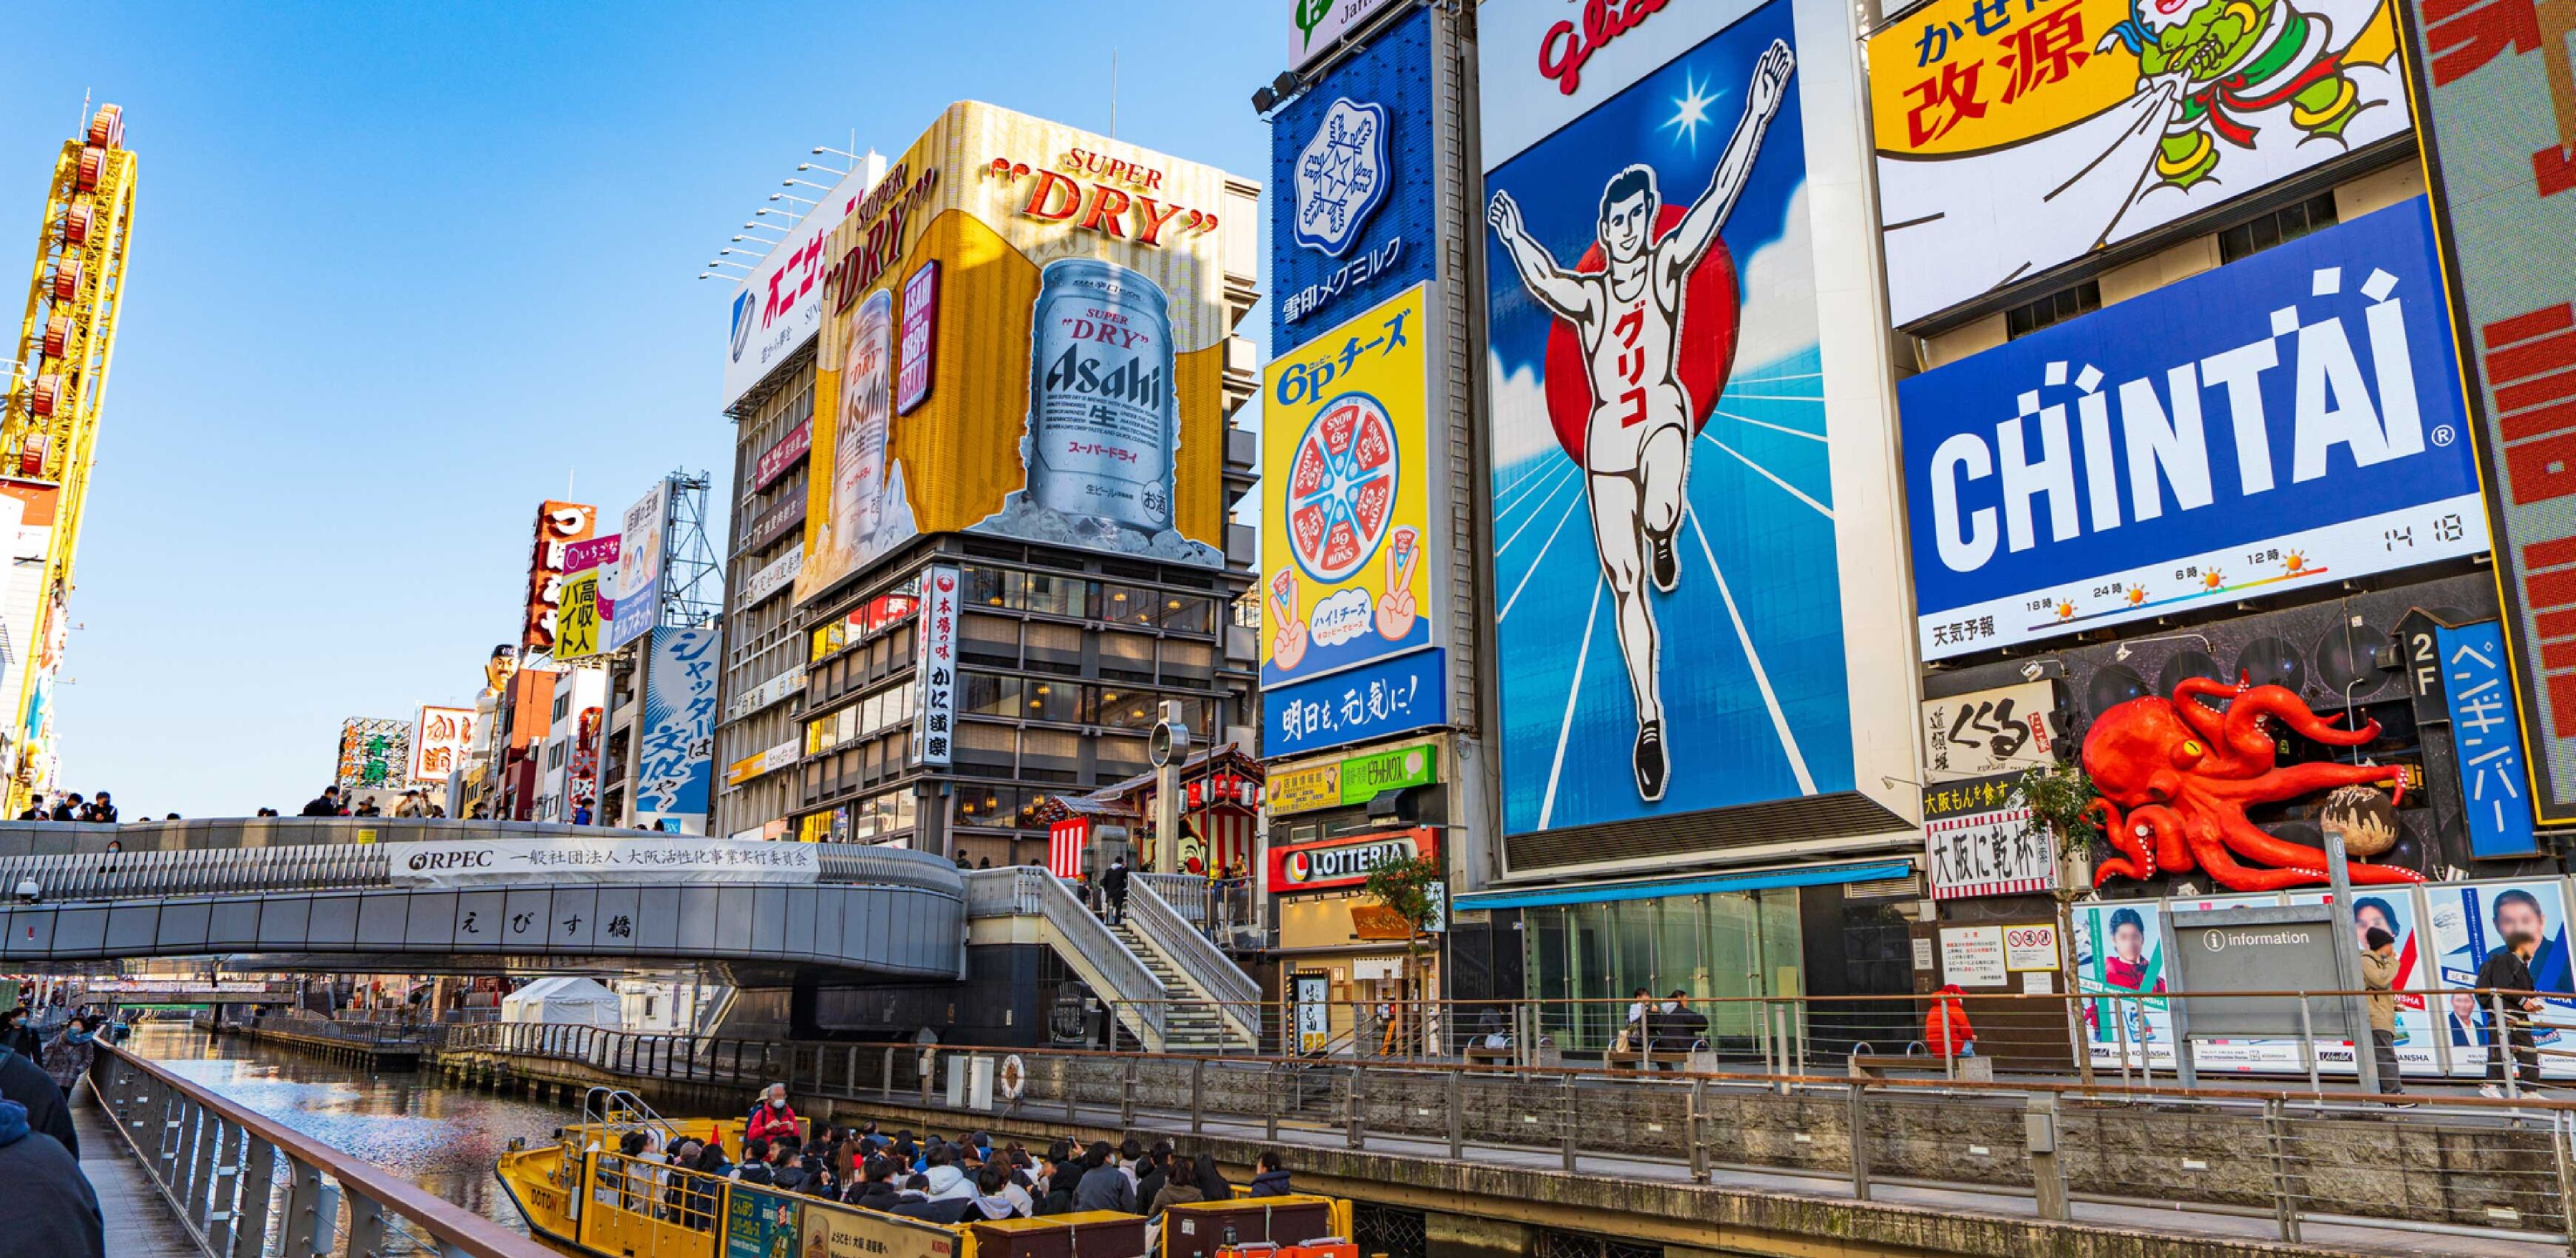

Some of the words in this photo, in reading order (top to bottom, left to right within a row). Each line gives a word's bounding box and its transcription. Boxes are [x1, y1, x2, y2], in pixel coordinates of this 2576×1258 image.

[1903, 5, 2090, 149] 改源
[1066, 148, 1162, 190] SUPER
[857, 163, 907, 231] SUPER
[903, 273, 932, 324] ASAHI
[1283, 237, 1401, 324] 雪印メグミルク
[1086, 307, 1129, 325] SUPER
[899, 358, 927, 406] OSAKA
[1046, 342, 1159, 410] Asahi
[1613, 299, 1647, 429] グリコ
[840, 371, 886, 445] Asahi
[1089, 405, 1117, 428] 生
[1327, 409, 1354, 431] SNOW
[1930, 267, 2426, 572] CHINTAI
[1068, 441, 1138, 463] スーパードライ
[2385, 526, 2412, 552] 14
[2433, 514, 2464, 543] 18
[2175, 565, 2198, 582] 6時
[2246, 548, 2280, 566] 12時
[2025, 598, 2053, 614] 18時
[2093, 582, 2123, 599] 24時
[560, 582, 581, 655] バイト
[934, 596, 952, 661] 本場の味
[1932, 615, 1996, 648] 天気予報
[2412, 633, 2436, 696] 2F
[1929, 705, 1949, 771] 道頓堀
[1948, 697, 2030, 758] くくる
[2451, 640, 2518, 833] ペンギンバー
[509, 849, 621, 865] 一般社団法人
[627, 849, 808, 867] 大阪活性化事業実行委員会
[1312, 842, 1404, 877] LOTTERIA
[1934, 823, 2034, 885] 大阪に乾杯
[463, 911, 632, 939] えびす橋
[2228, 929, 2310, 946] information
[931, 1239, 950, 1255] KIRIN
